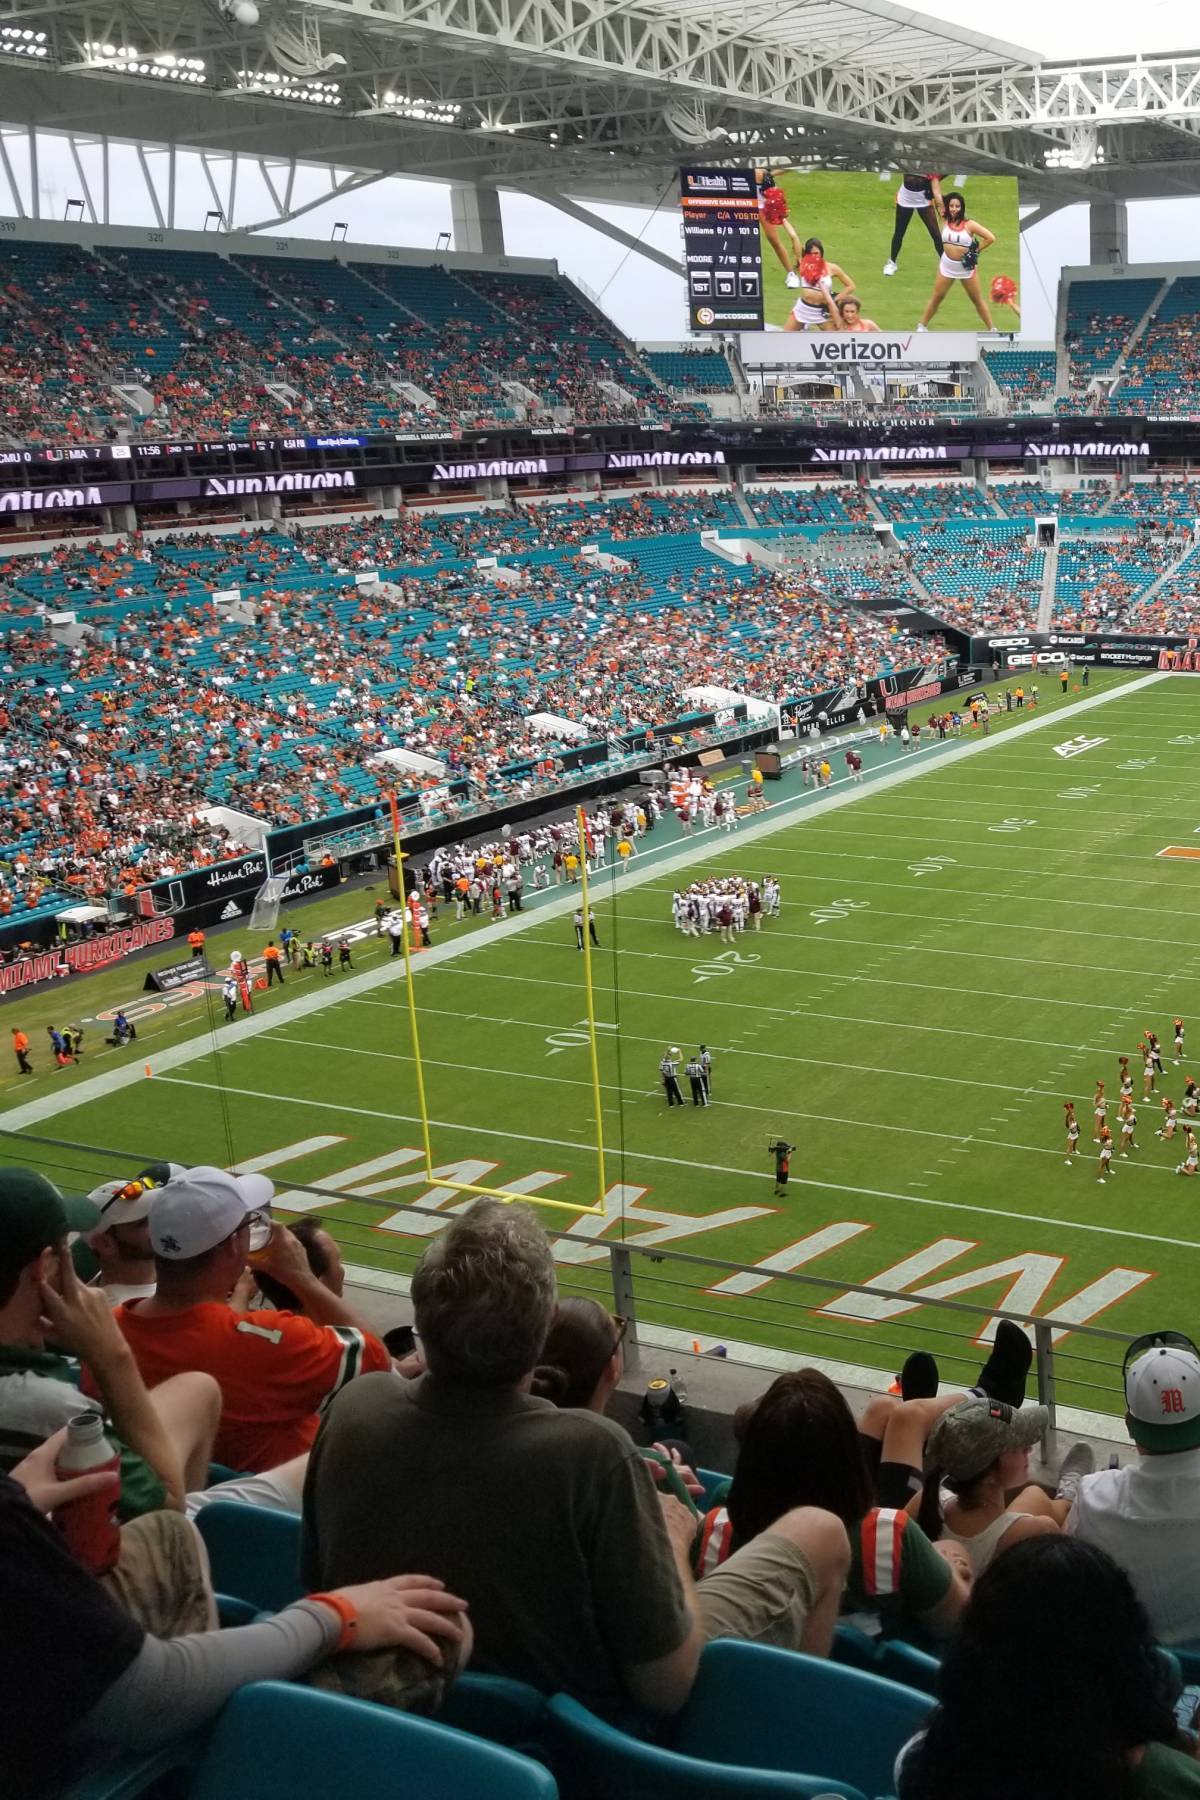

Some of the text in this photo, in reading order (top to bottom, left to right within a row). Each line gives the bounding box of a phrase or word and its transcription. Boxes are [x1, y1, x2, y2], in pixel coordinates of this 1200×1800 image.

[685, 211, 706, 219] Player
[147, 232, 163, 243] 320
[687, 255, 713, 263] MOORE
[693, 283, 753, 292] 1ST 10 7
[810, 337, 902, 360] verizon
[848, 418, 935, 428] RING HONOR
[421, 432, 452, 440] MARYLAND
[24, 453, 32, 462] 0
[70, 449, 88, 459] MIA
[94, 449, 100, 458] 7
[138, 446, 160, 456] 11:56
[227, 443, 236, 451] 10
[988, 637, 1030, 648] GEICO
[1126, 653, 1152, 661] Mortgage
[907, 682, 942, 704] HURRICANES
[826, 714, 846, 725] ELLIS
[1052, 734, 1104, 757] ACC
[988, 818, 1038, 833] 50
[242, 861, 264, 876] Park
[907, 855, 957, 873] 40
[301, 875, 323, 892] Park
[220, 909, 242, 920] adidas
[810, 899, 871, 919] 30
[65, 917, 175, 968] HURRICANES
[690, 951, 761, 976] 20
[545, 1019, 621, 1047] 10
[237, 1320, 283, 1345] 1
